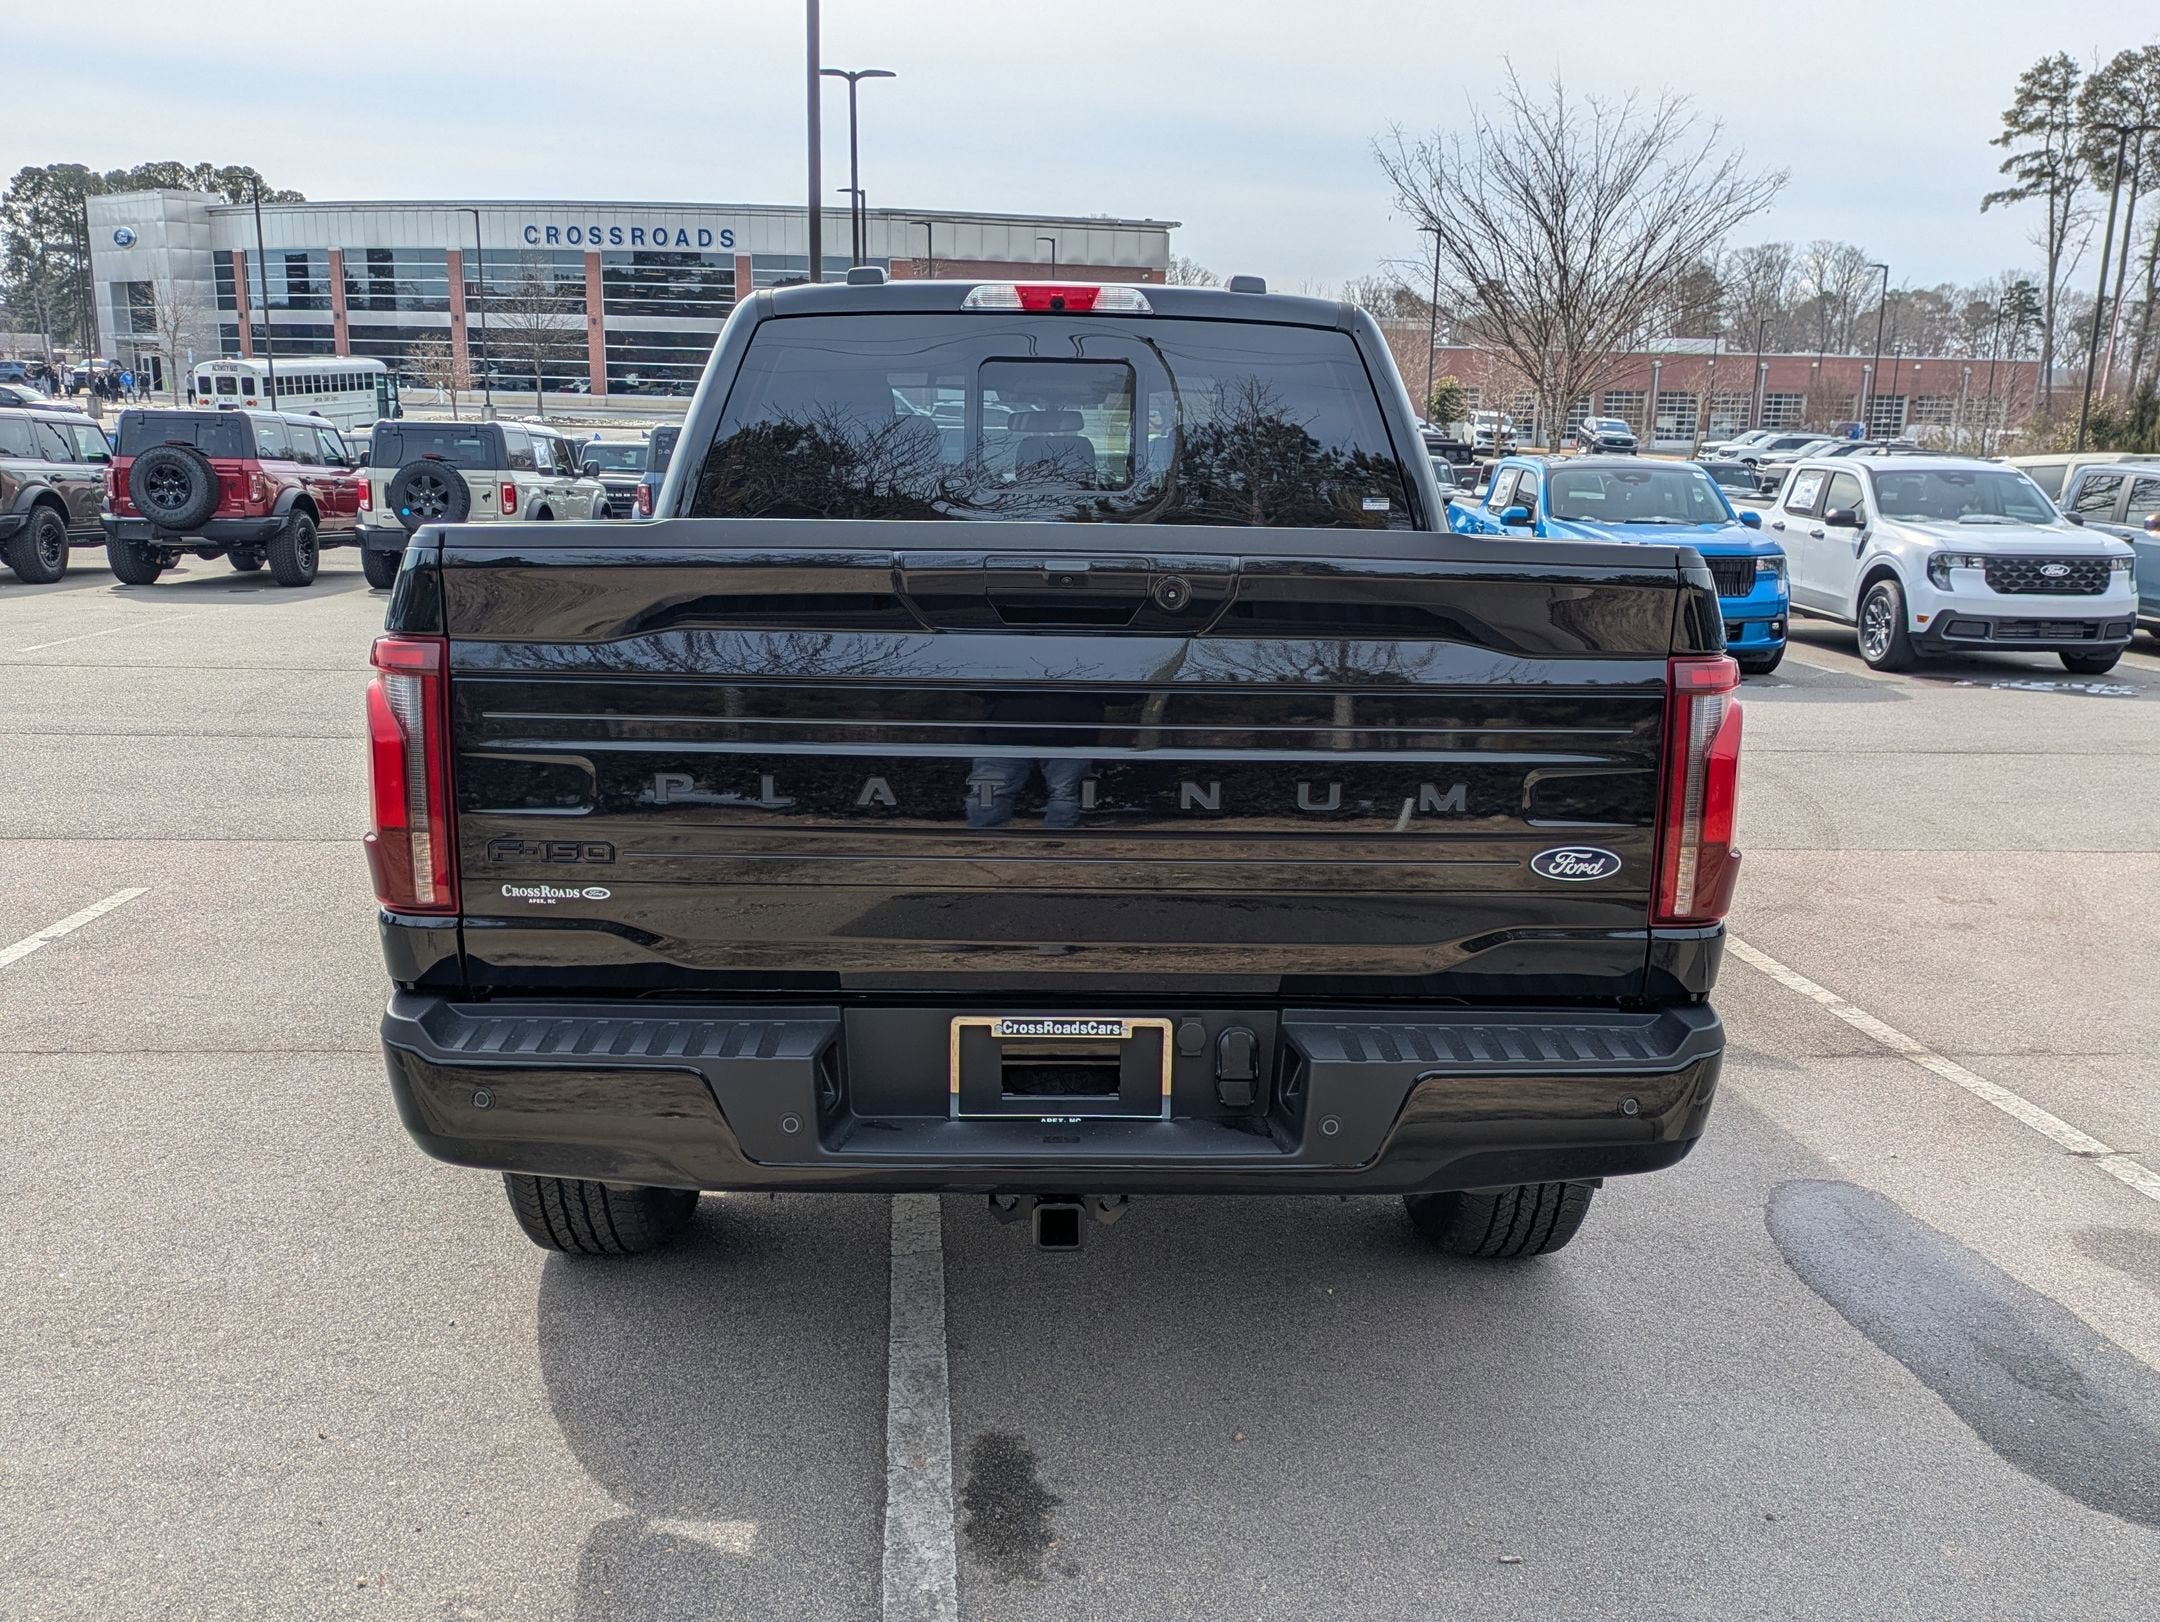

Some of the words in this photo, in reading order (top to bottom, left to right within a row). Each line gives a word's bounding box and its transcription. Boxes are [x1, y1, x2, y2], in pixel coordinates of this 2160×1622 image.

[523, 225, 736, 248] CROSSROADS
[654, 772, 1468, 812] PLATINUM
[487, 839, 616, 864] F-150
[1548, 851, 1606, 875] Ford
[1002, 1020, 1121, 1036] CrossRoadsCars
